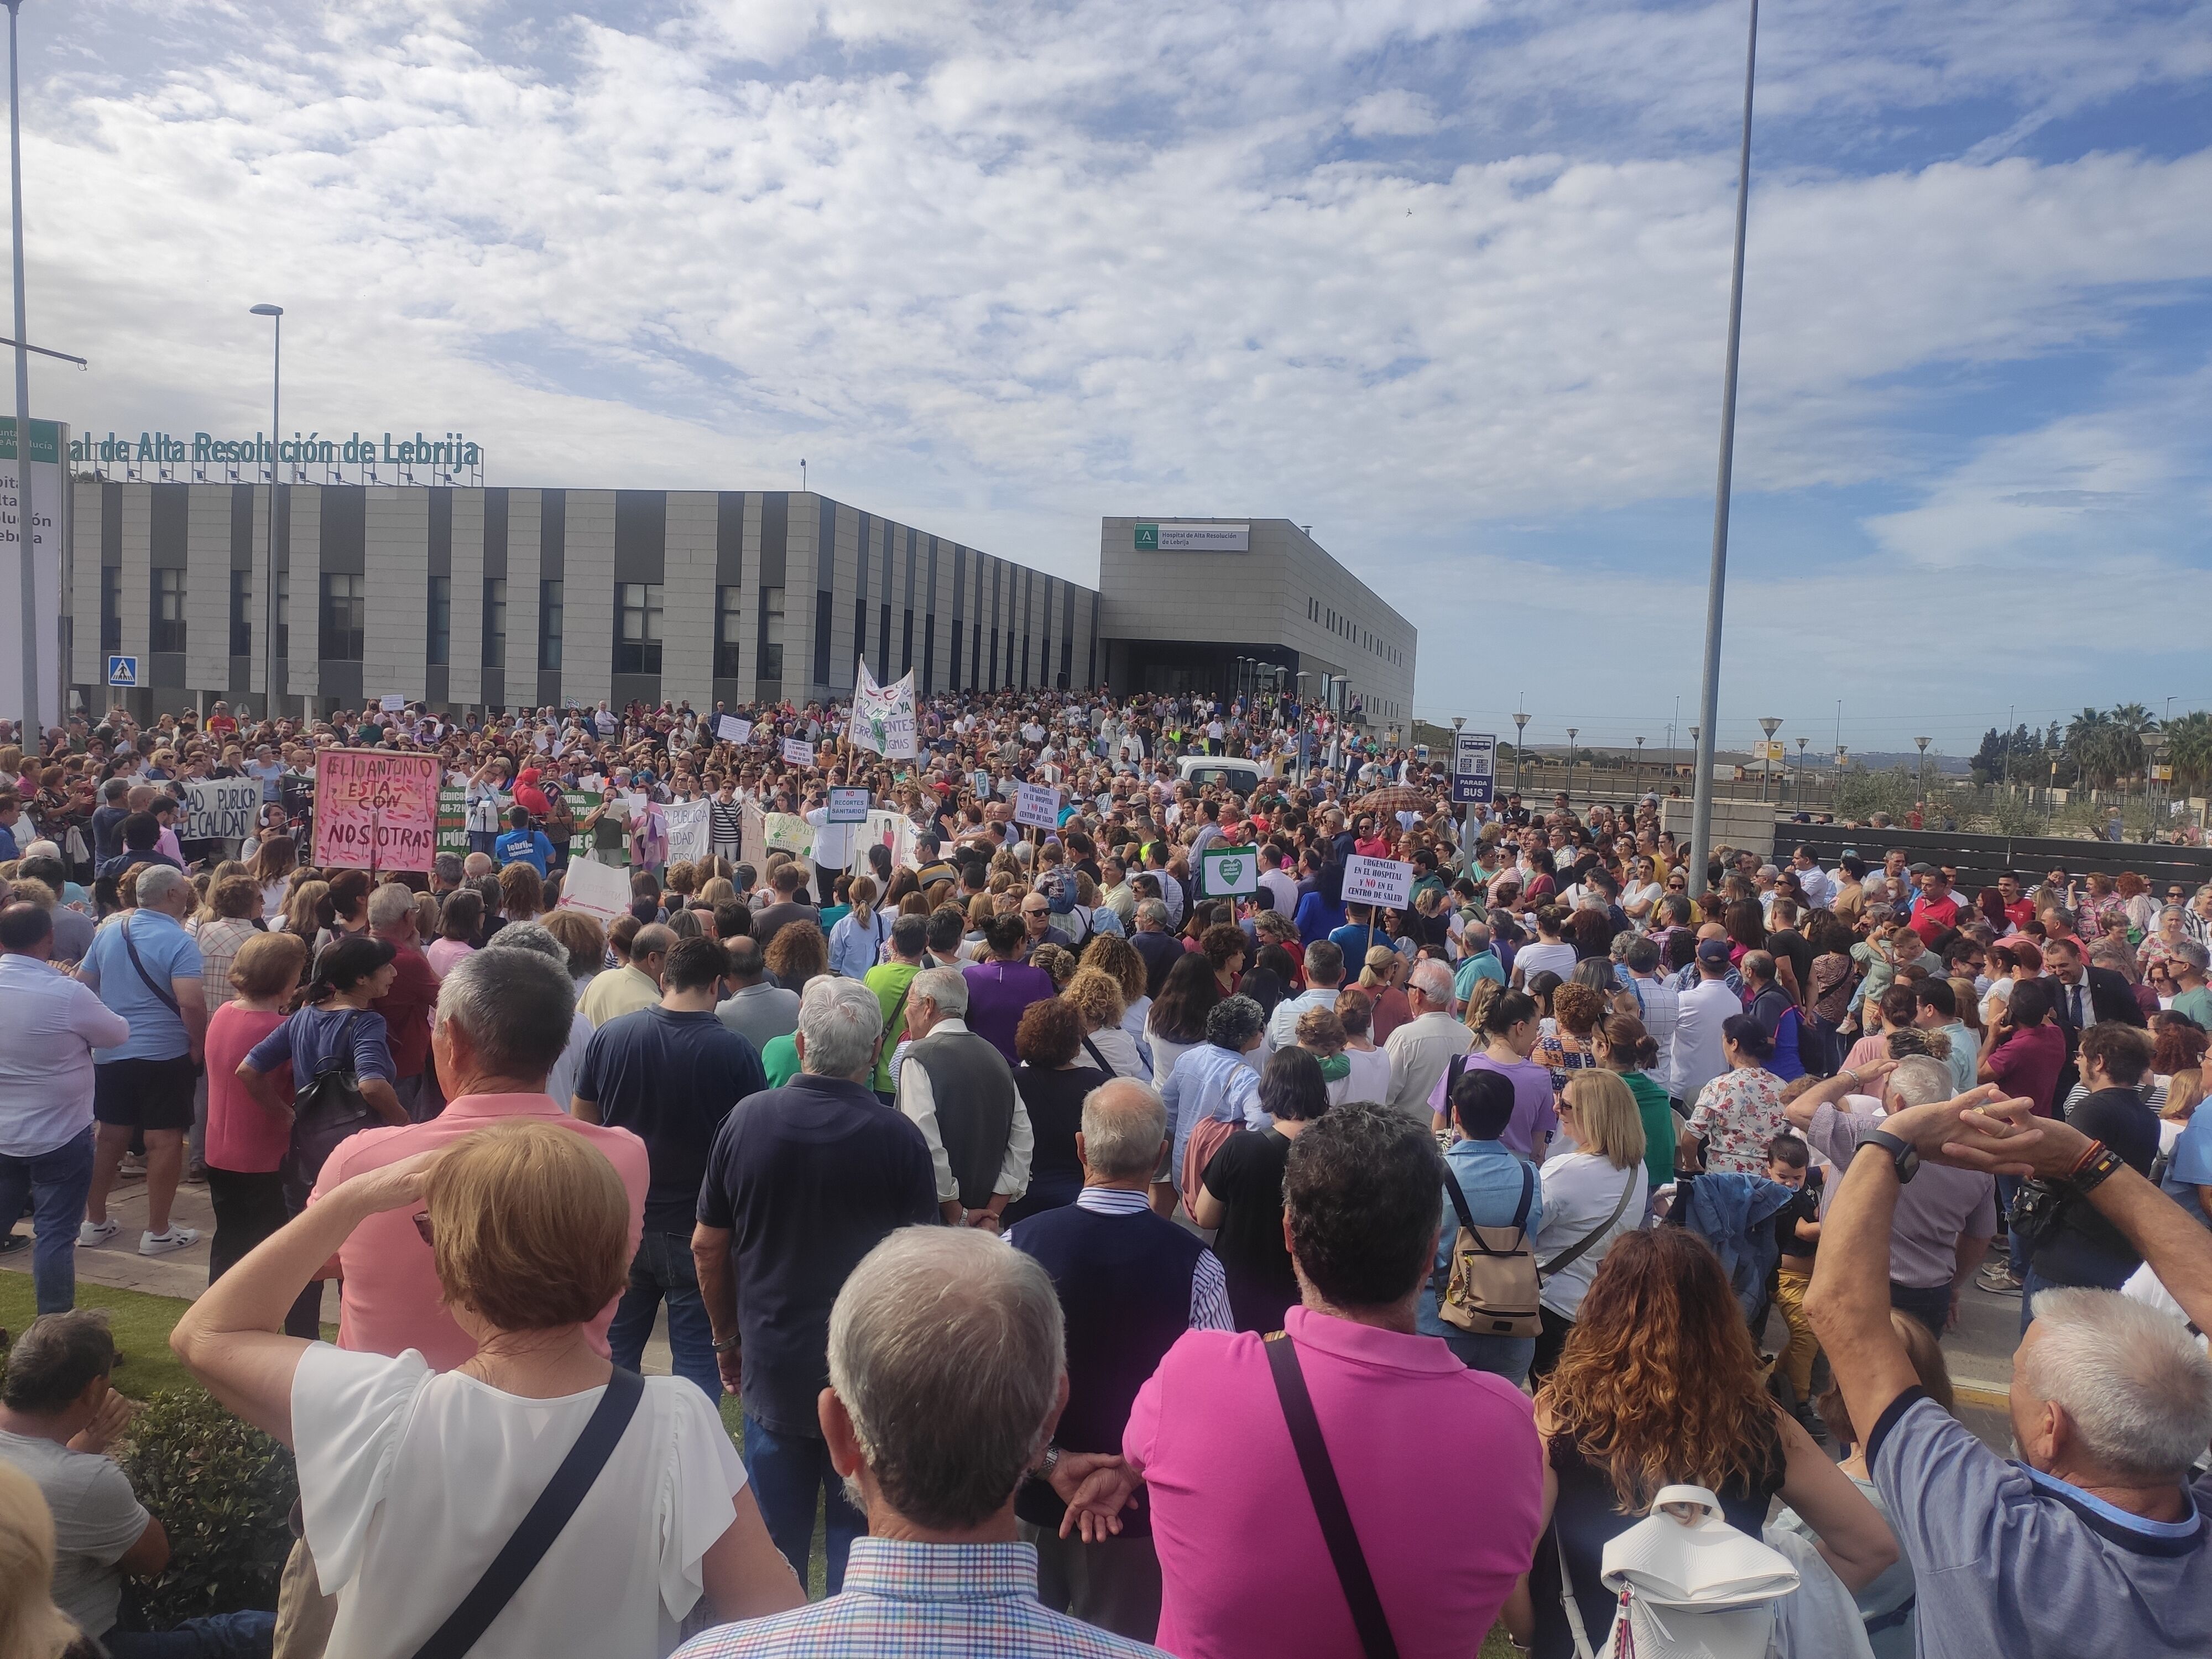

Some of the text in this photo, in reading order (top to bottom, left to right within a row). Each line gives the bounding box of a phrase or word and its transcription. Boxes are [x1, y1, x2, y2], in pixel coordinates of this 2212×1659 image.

[100, 431, 129, 462] de
[137, 431, 185, 462] Alta
[195, 431, 333, 463] Resolución
[343, 432, 375, 463] de
[384, 432, 479, 473] Lebrija
[1029, 785, 1050, 796] URGENCIAS
[1463, 787, 1484, 797] BUS
[358, 794, 402, 811] CON
[1035, 795, 1053, 805] HOSPITAL
[1031, 803, 1038, 812] NO
[1019, 811, 1035, 820] CENTRO
[1042, 815, 1053, 824] SALUD
[569, 834, 583, 849] DE
[1363, 858, 1396, 870] URGENCIAS
[1363, 868, 1371, 876] EL
[1372, 869, 1402, 881] HOSPITAL
[1365, 878, 1376, 888] NO
[1386, 883, 1394, 891] EL
[1348, 886, 1372, 897] CENTRO
[1373, 891, 1382, 899] DE
[1383, 892, 1402, 902] SALUD
